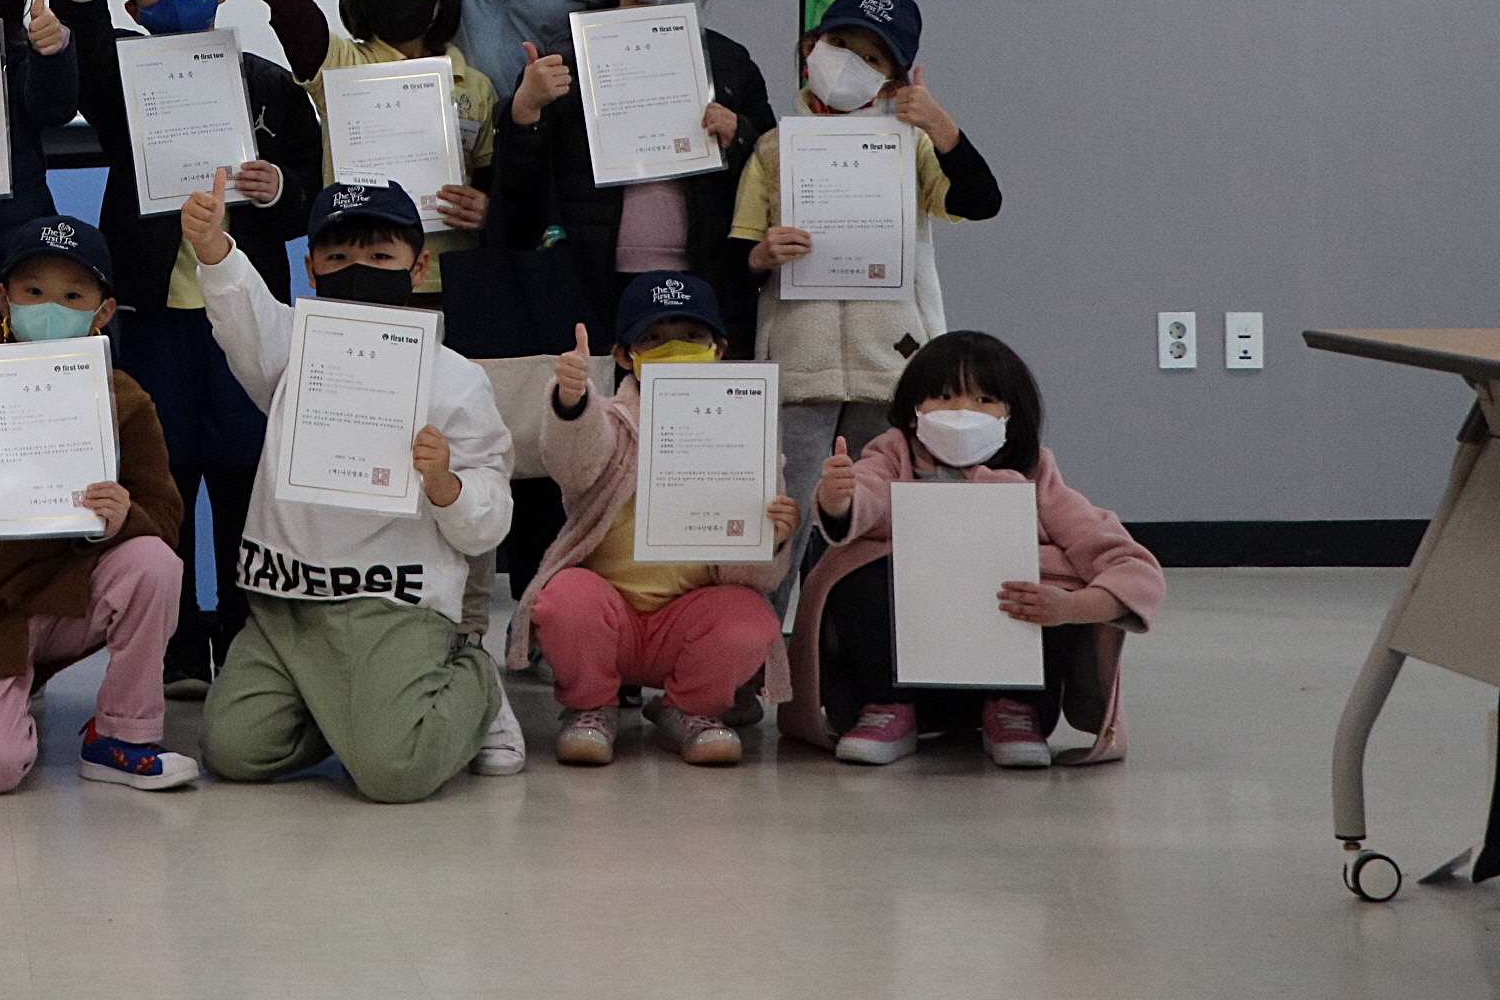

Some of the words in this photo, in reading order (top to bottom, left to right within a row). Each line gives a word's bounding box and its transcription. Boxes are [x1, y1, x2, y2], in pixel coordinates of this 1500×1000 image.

[859, 2, 877, 12] First
[879, 10, 893, 22] Tee
[333, 192, 349, 200] The
[333, 197, 350, 206] First
[356, 195, 370, 203] Tee
[41, 227, 59, 236] The
[40, 232, 59, 243] First
[64, 238, 78, 247] Tee
[651, 286, 668, 294] The
[653, 293, 671, 302] First
[676, 291, 691, 299] Tee
[390, 334, 404, 343] first
[406, 336, 418, 344] tee
[62, 364, 76, 372] first
[735, 388, 749, 396] first
[749, 388, 762, 396] tee
[238, 538, 424, 605] TAVERSE
